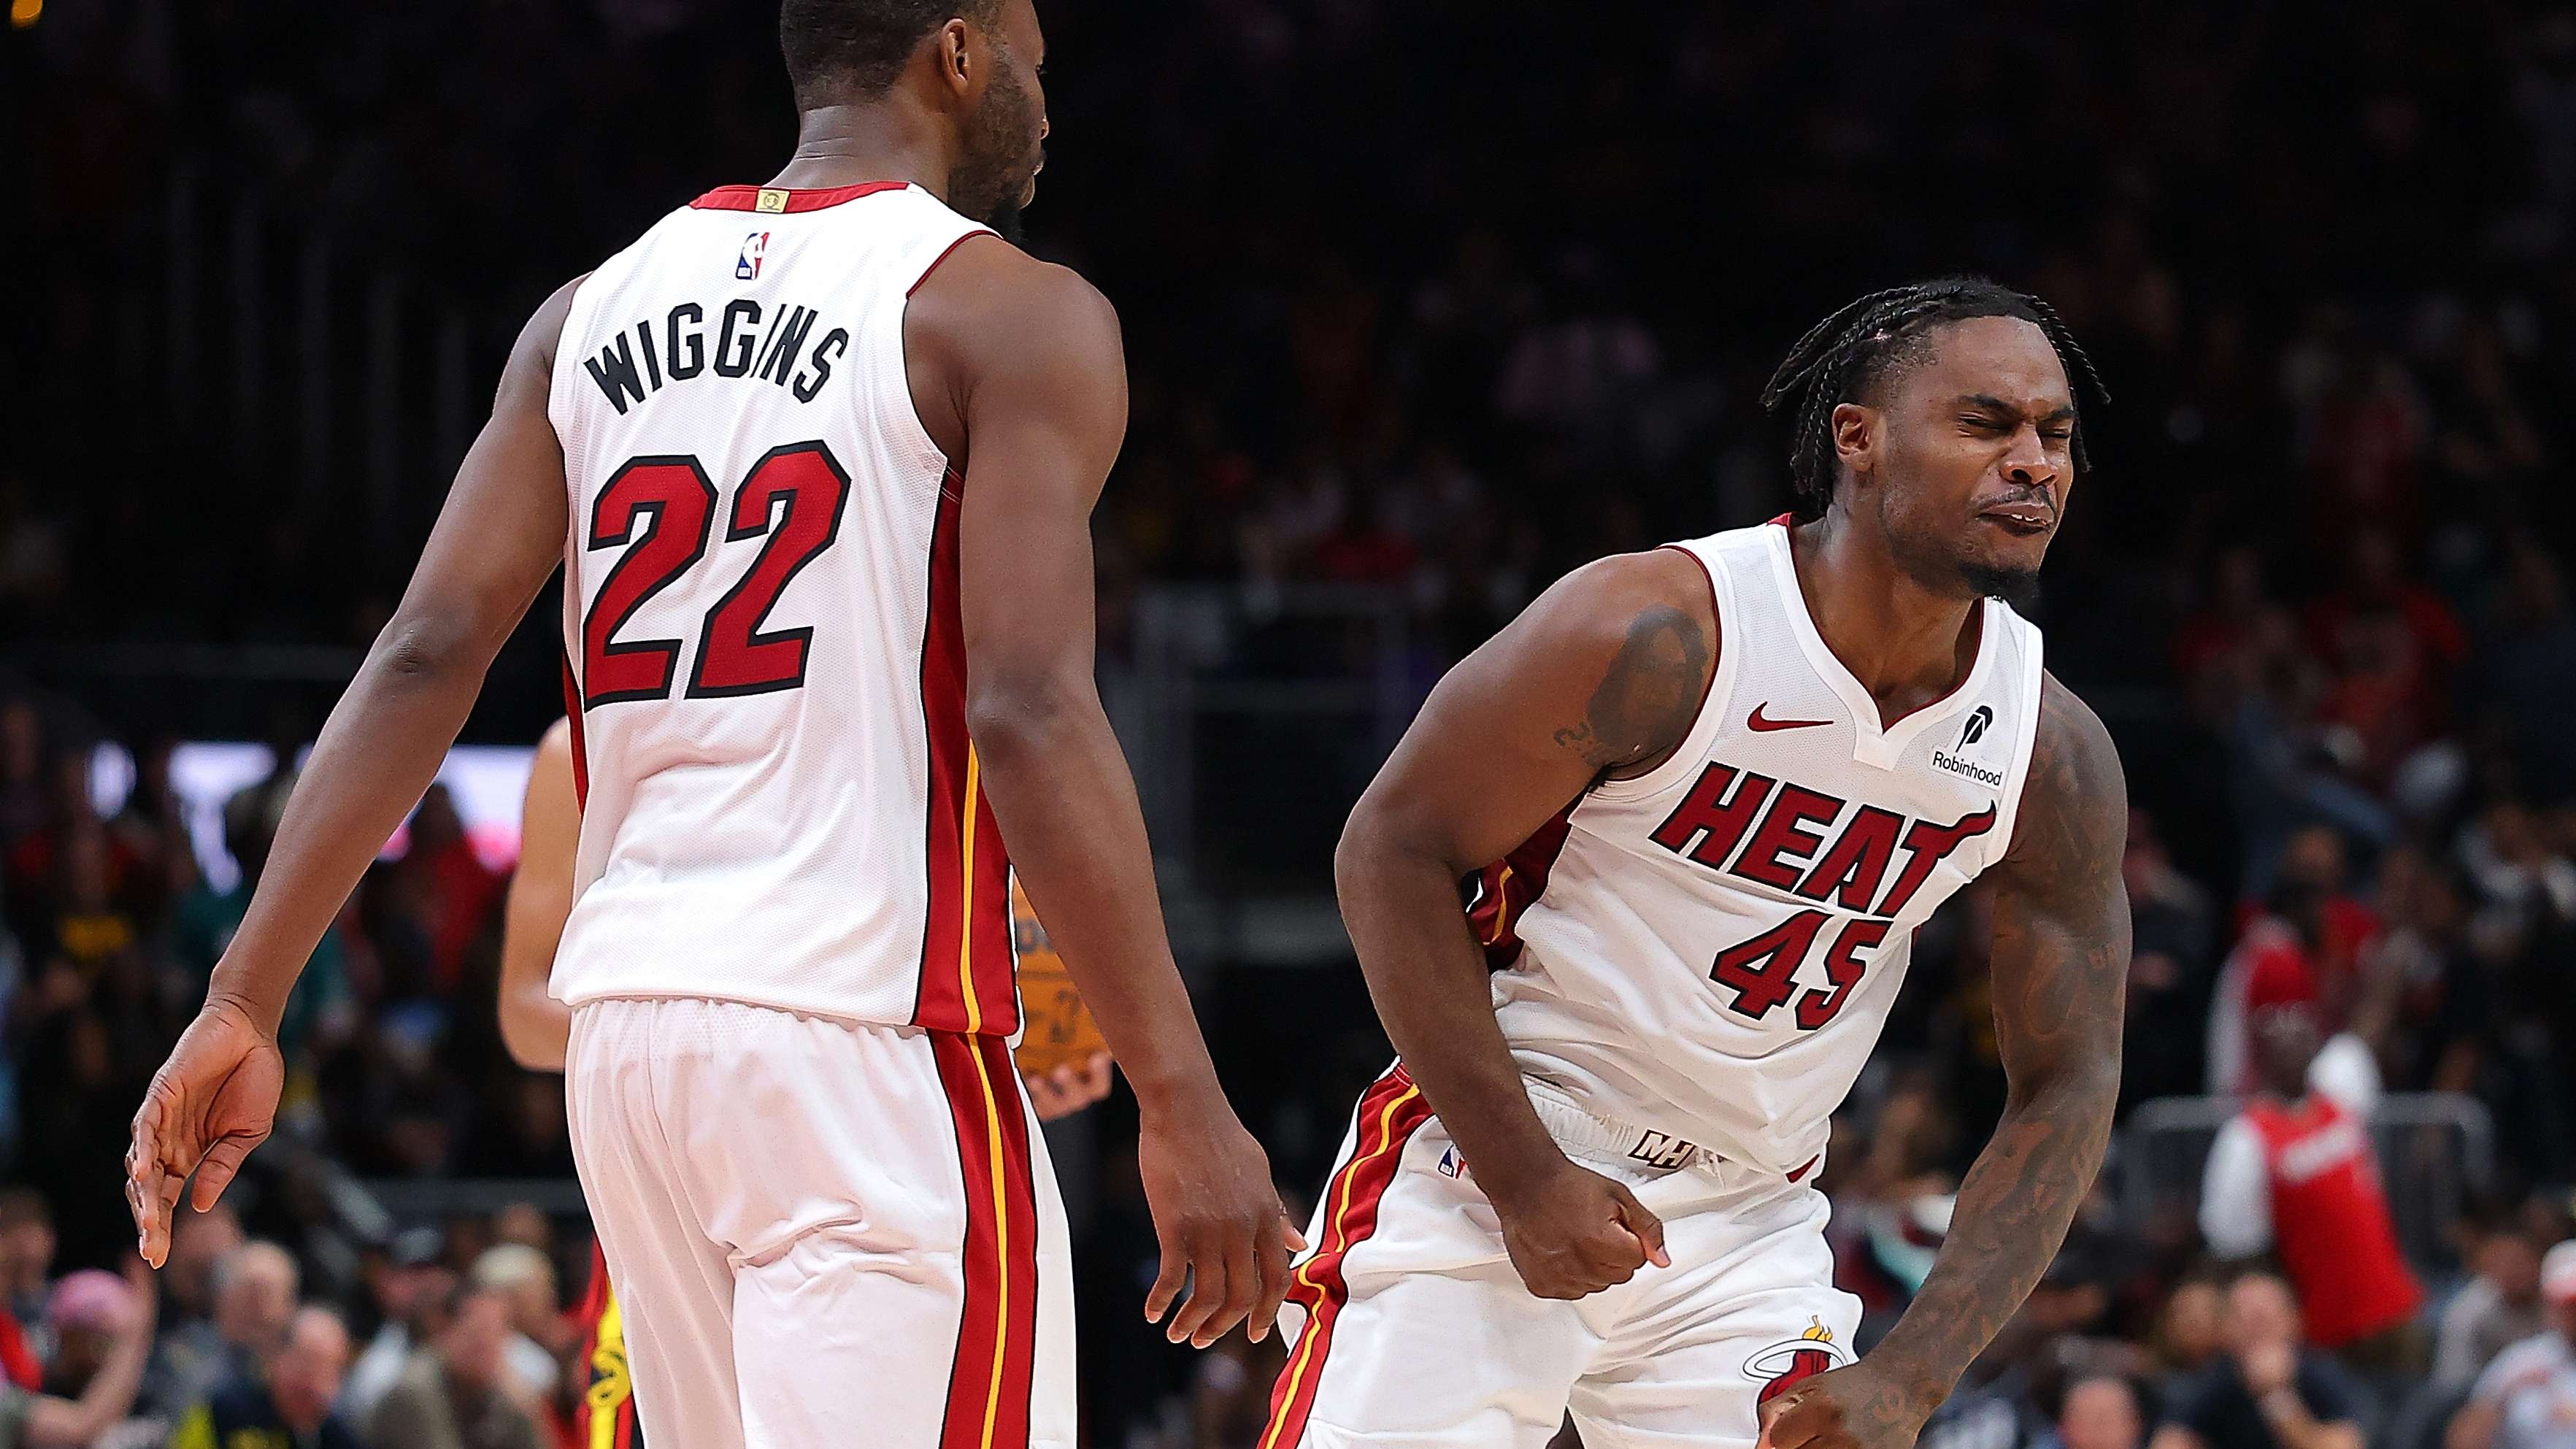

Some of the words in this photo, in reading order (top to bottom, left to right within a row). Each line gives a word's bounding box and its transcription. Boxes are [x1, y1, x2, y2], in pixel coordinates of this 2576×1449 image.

[585, 299, 849, 415] WIGGINS
[583, 440, 851, 712] 22
[1933, 750, 2002, 786] Robinhood
[1648, 761, 1996, 918] HEAT
[1709, 909, 1893, 1031] 45
